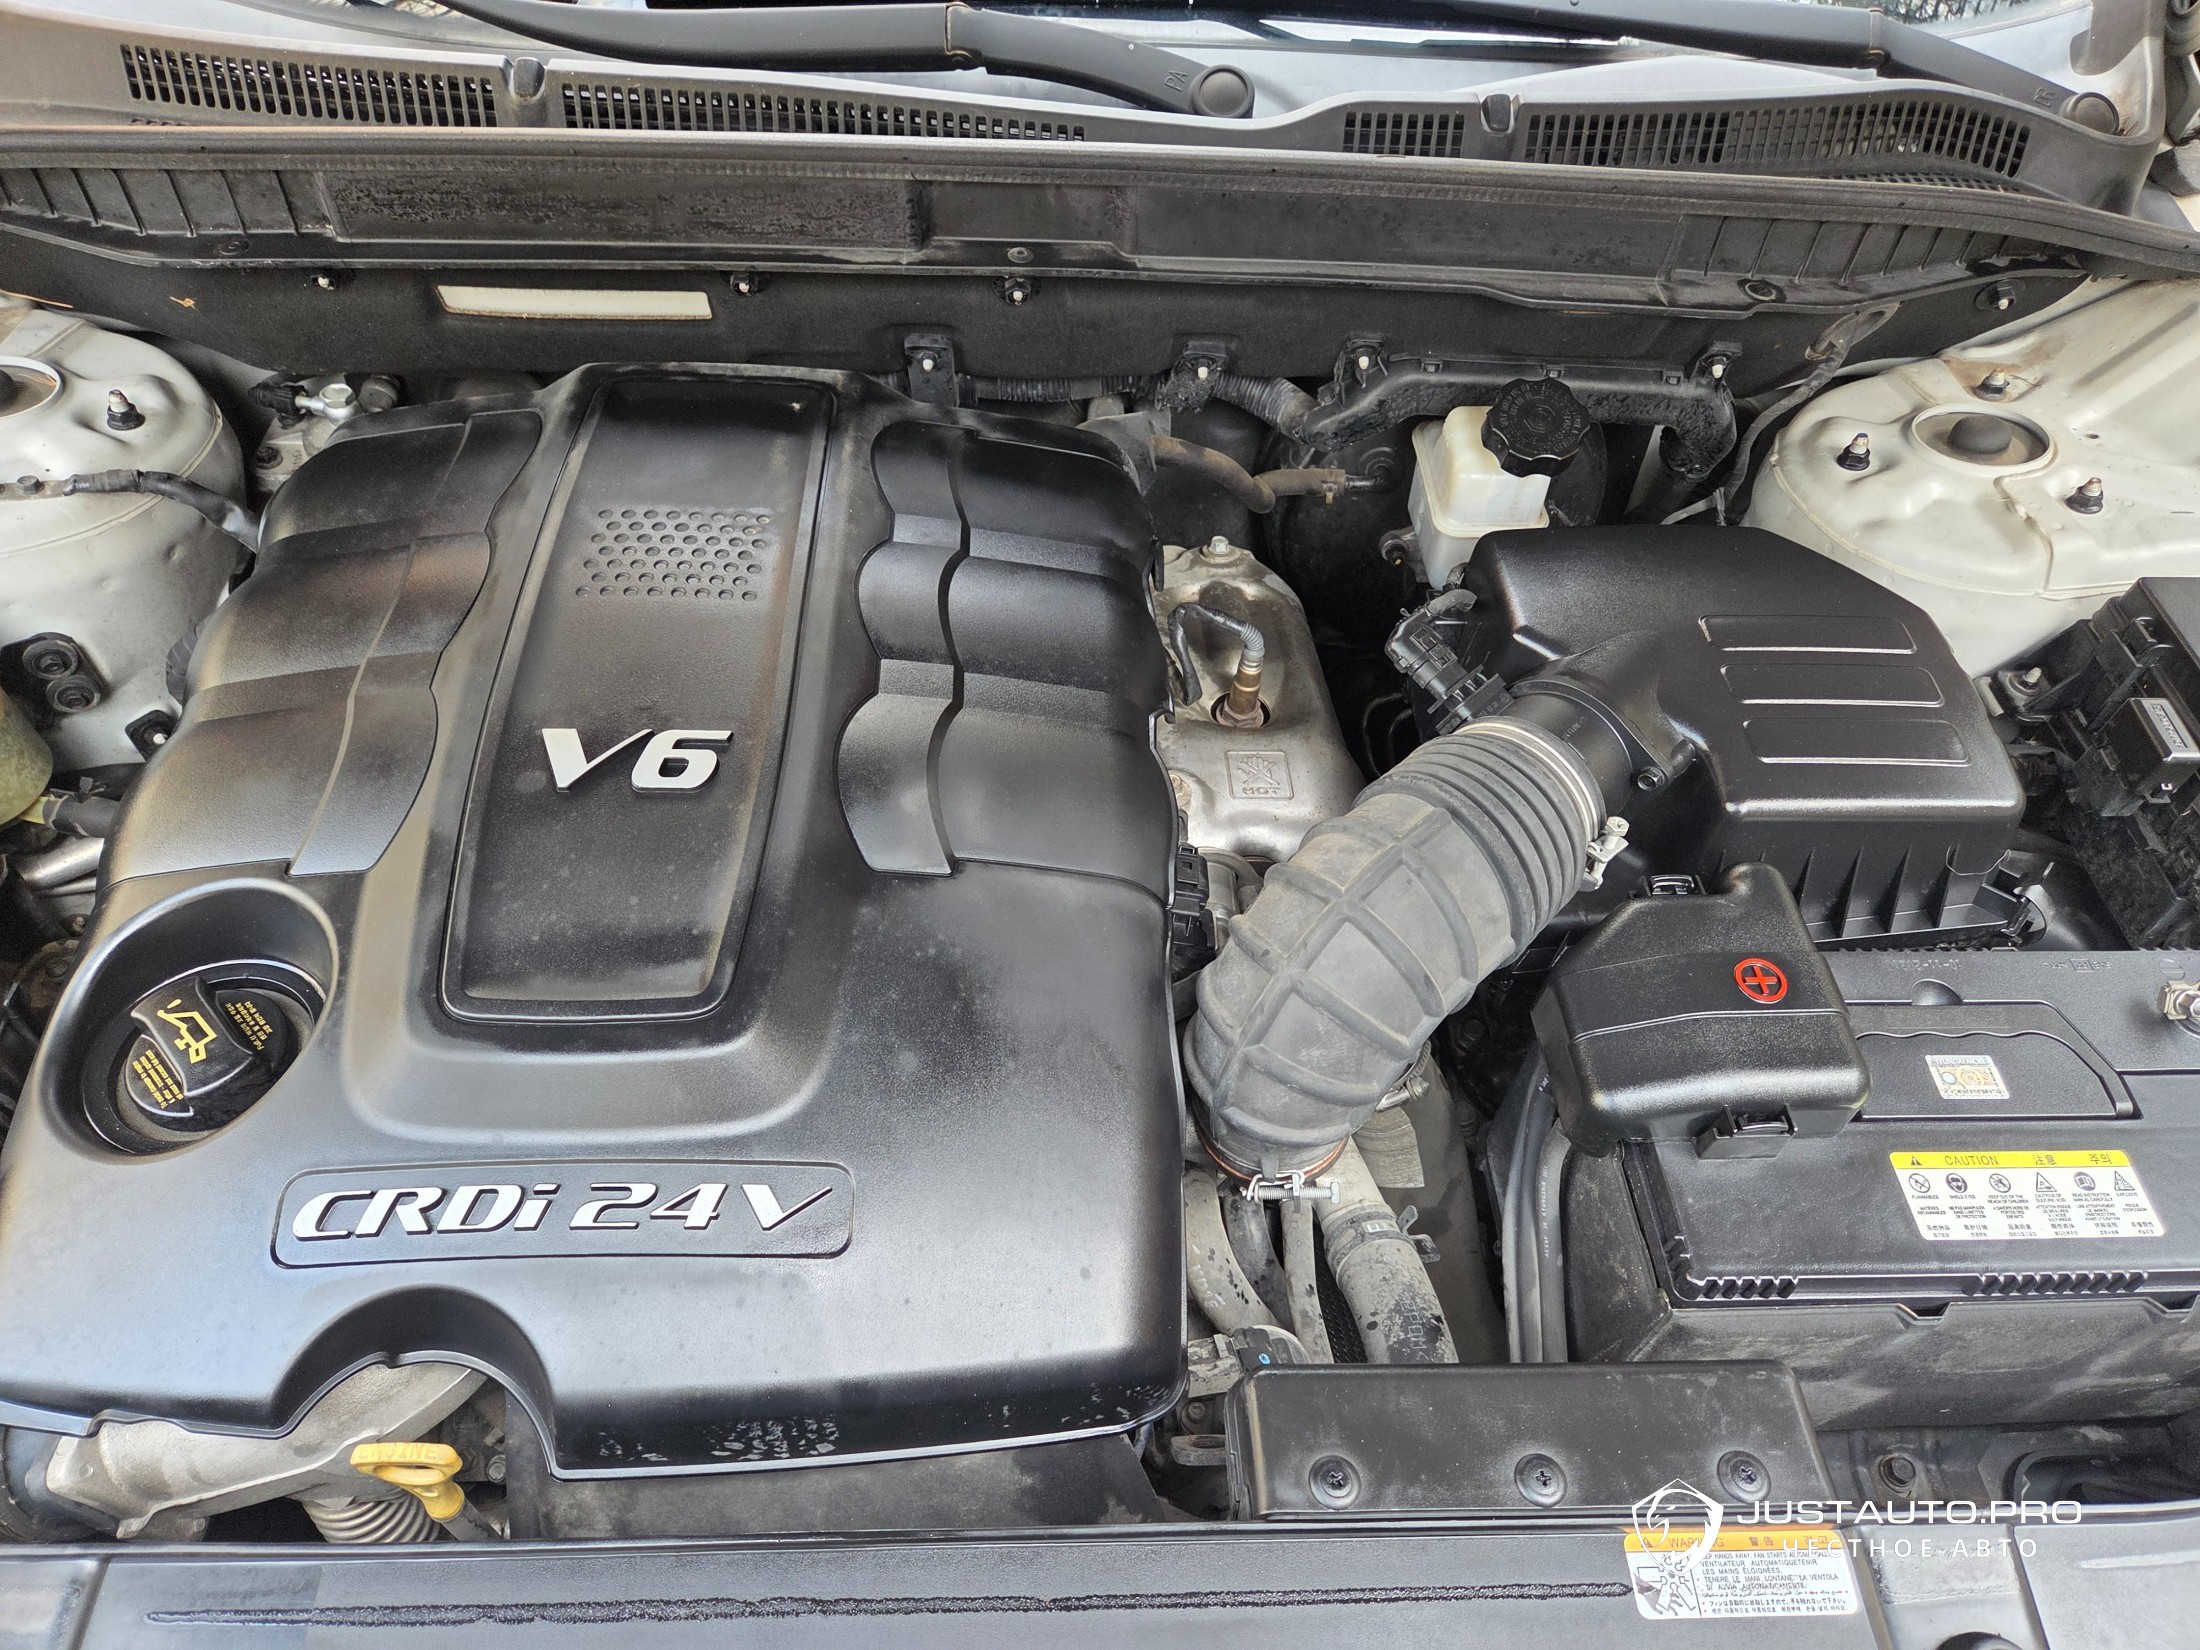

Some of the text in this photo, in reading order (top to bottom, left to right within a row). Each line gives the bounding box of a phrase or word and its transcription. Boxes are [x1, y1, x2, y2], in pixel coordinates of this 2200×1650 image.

[1164, 70, 1188, 92] PA
[541, 727, 734, 793] V6
[1944, 1155, 1999, 1166] CAUTION
[2088, 1153, 2112, 1164] 주의
[291, 1182, 561, 1241] CRDi
[358, 1444, 436, 1460] ENGINE
